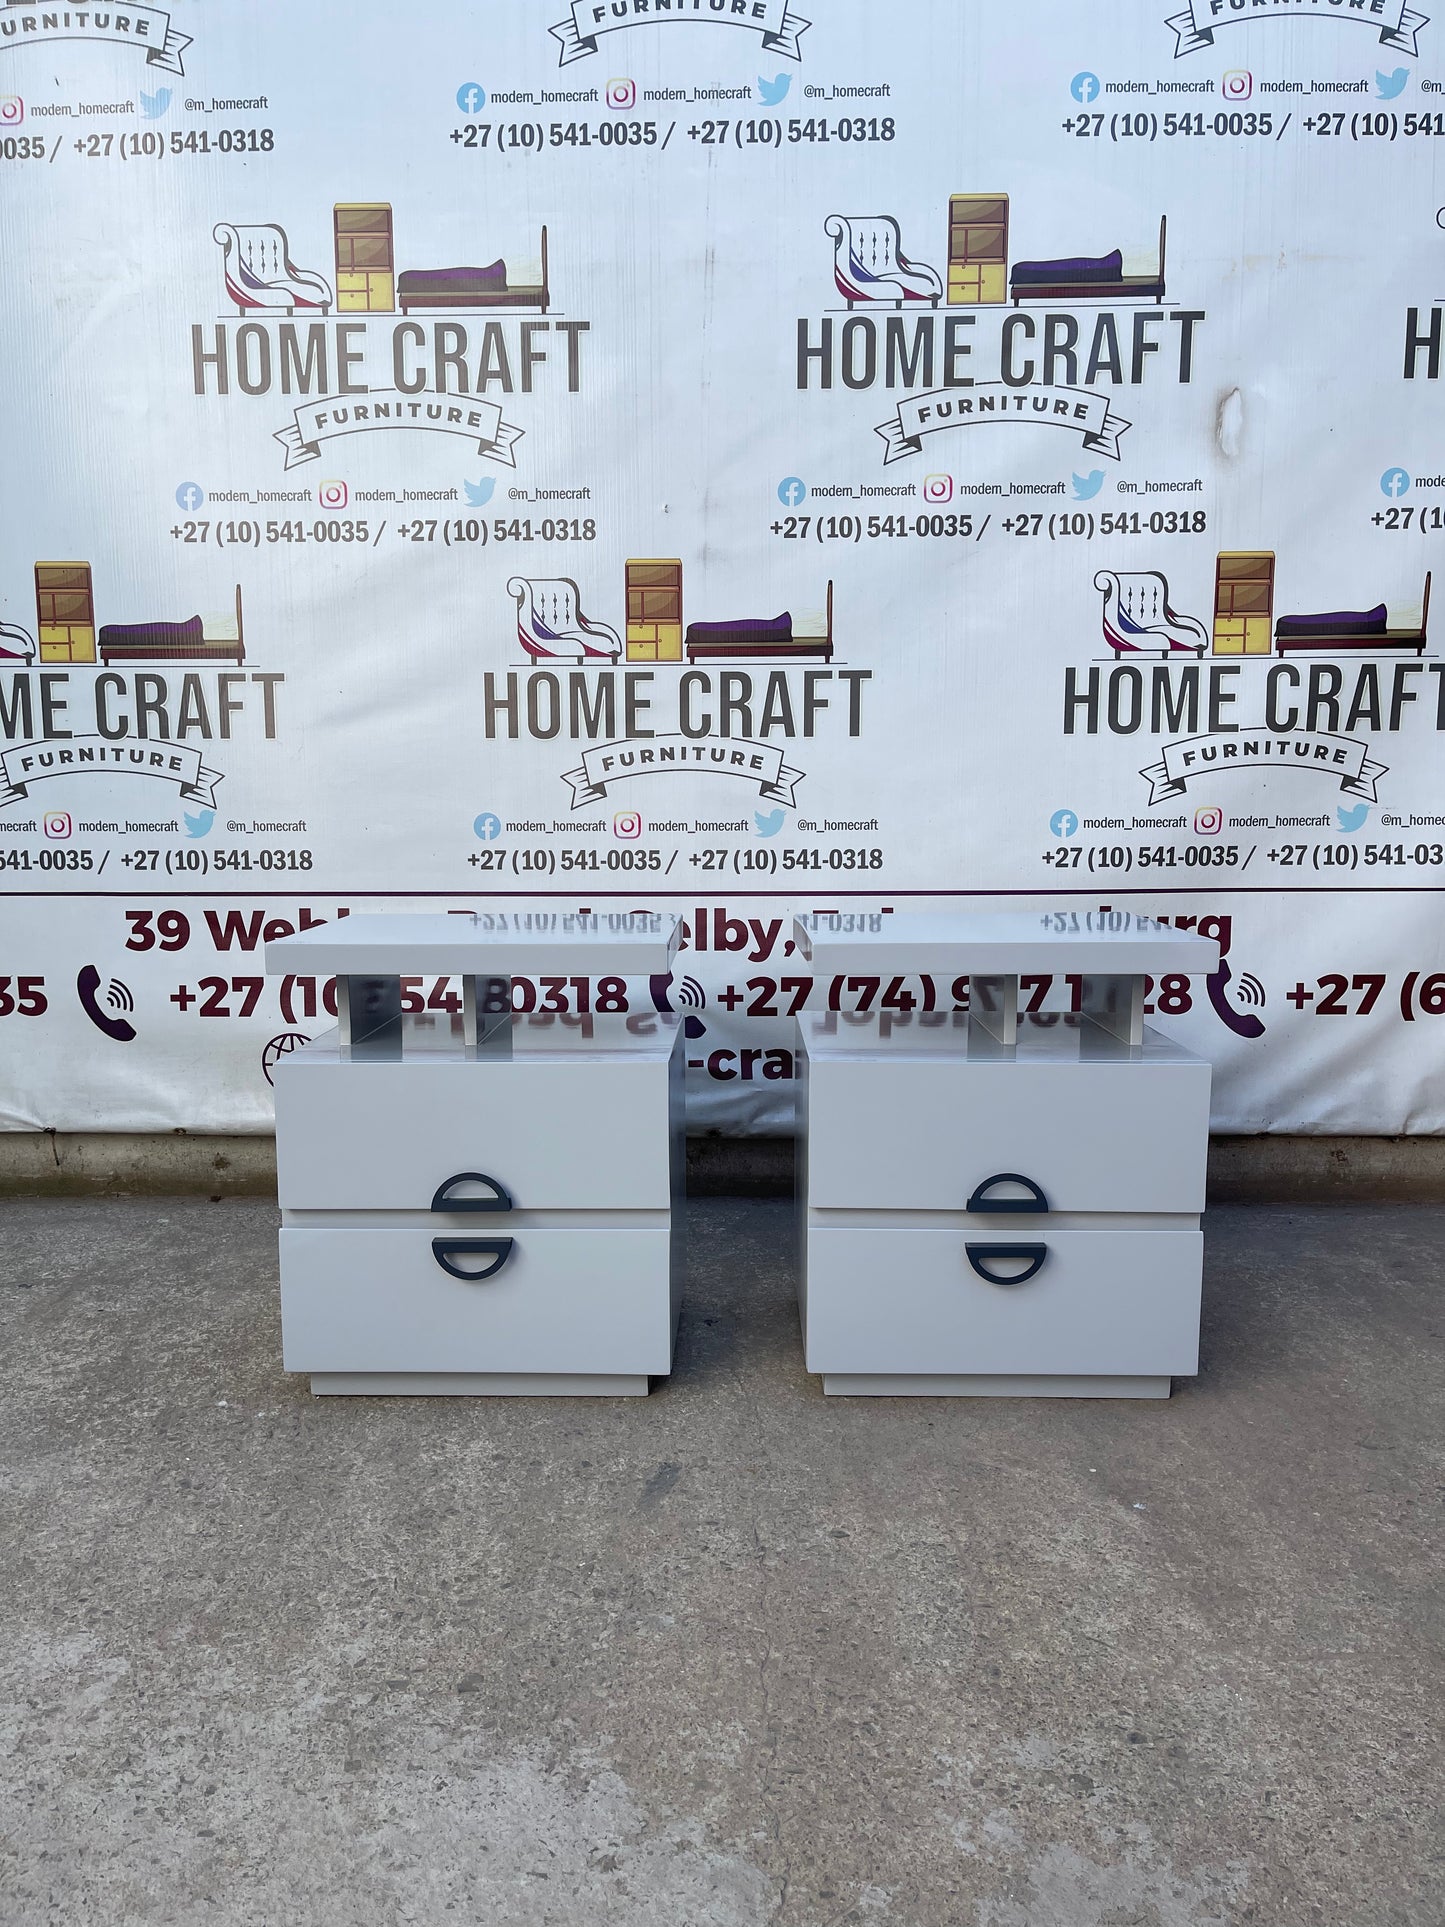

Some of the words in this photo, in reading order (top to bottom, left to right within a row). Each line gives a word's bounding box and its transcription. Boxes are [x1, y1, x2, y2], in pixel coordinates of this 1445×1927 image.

[185, 96, 268, 112] @m_homecraft
[804, 84, 890, 100] @m_homecraft
[450, 125, 491, 147] +27
[498, 124, 543, 152] (10)
[550, 122, 657, 146] 541-0035
[688, 121, 729, 143] +27
[736, 120, 781, 148] (10)
[788, 118, 895, 142] 541-0318
[1062, 114, 1104, 136] +27
[1111, 113, 1157, 141] (10)
[1164, 113, 1272, 136] 541-0035
[1303, 113, 1345, 135] +27
[1351, 113, 1397, 141] (10)
[0, 136, 45, 160] 035
[74, 134, 113, 156] +27
[120, 132, 164, 160] (10)
[171, 129, 274, 153] 541-0318
[193, 323, 367, 395] HOME
[390, 321, 589, 395] CRAFT
[798, 316, 978, 390] HOME
[1000, 311, 1204, 388] CRAFT
[314, 402, 482, 429] FURNITURE
[919, 395, 1086, 423] FURNITURE
[508, 487, 590, 502] @m_homecraft
[1117, 479, 1202, 494] @m_homecraft
[170, 521, 209, 542] +27
[216, 521, 260, 547] (10)
[266, 521, 369, 542] 541-0035
[398, 520, 437, 541] +27
[444, 520, 488, 546] (10)
[494, 519, 596, 541] 541-0318
[771, 517, 811, 538] +27
[817, 516, 861, 543] (10)
[867, 515, 972, 537] 541-0035
[1002, 514, 1043, 535] +27
[1049, 514, 1094, 540] (10)
[1100, 511, 1206, 534] 541-0318
[1371, 507, 1414, 530] +27
[1420, 507, 1445, 534] (1
[0, 673, 74, 740] ME
[93, 673, 283, 741] CRAFT
[485, 672, 658, 740] HOME
[678, 670, 871, 740] CRAFT
[1065, 666, 1242, 735] HOME
[22, 746, 183, 771] FURNITURE
[603, 746, 765, 771] FURNITURE
[1183, 740, 1348, 766] FURNITURE
[227, 820, 306, 833] @m_homecraft
[798, 819, 878, 832] @m_homecraft
[121, 850, 159, 870] +27
[166, 850, 208, 875] (10)
[214, 850, 312, 870] 541-0318
[468, 850, 506, 870] +27
[513, 850, 555, 875] (10)
[561, 850, 661, 870] 541-0035
[689, 850, 728, 869] +27
[734, 850, 776, 874] (10)
[783, 849, 882, 869] 541-0318
[1042, 847, 1082, 867] +27
[1088, 847, 1132, 872] (10)
[1138, 846, 1238, 867] 541-0035
[1267, 845, 1307, 865] +27
[1313, 845, 1358, 870] (10)
[1364, 844, 1444, 866] 541-03
[125, 910, 190, 951] 39
[170, 977, 264, 1017] +27
[718, 977, 813, 1016] +27
[828, 975, 936, 1012] (74)
[1287, 974, 1386, 1015] +27
